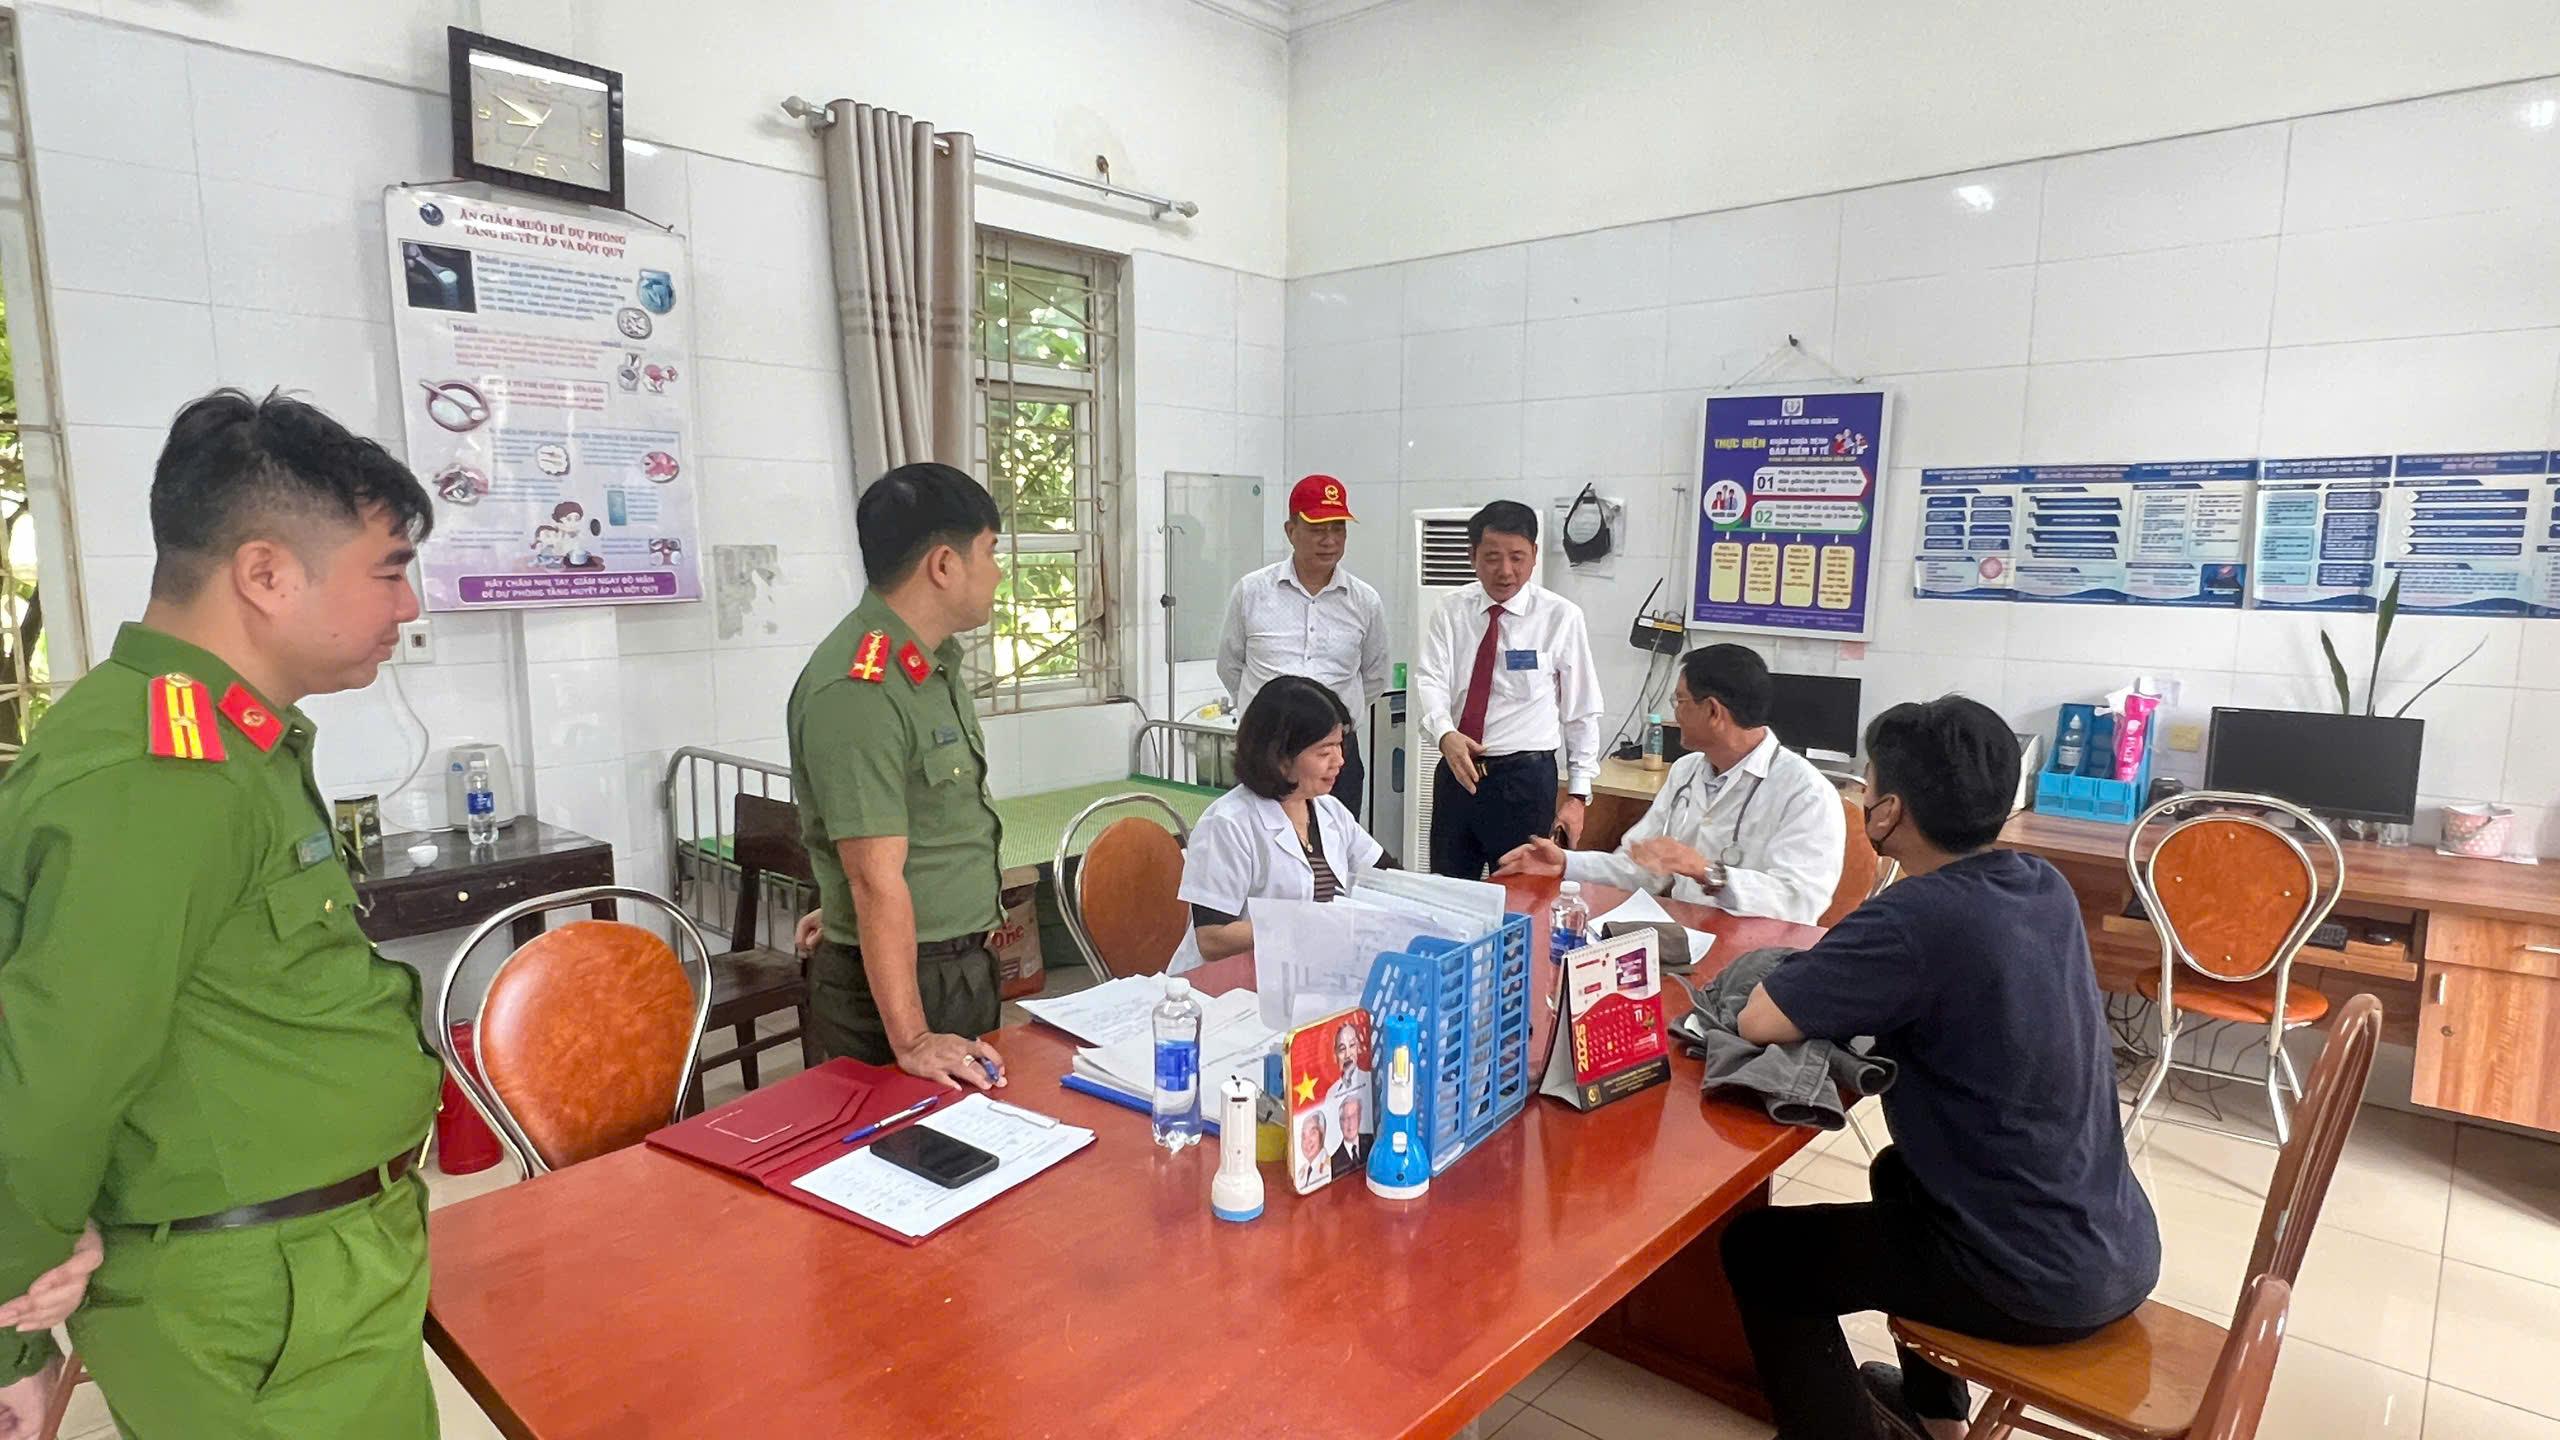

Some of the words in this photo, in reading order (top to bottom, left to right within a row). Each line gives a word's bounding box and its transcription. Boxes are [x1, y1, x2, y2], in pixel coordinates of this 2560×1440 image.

[1757, 476, 1774, 490] 01
[1755, 510, 1773, 523] 02
[1575, 1023, 1590, 1073] 2025
